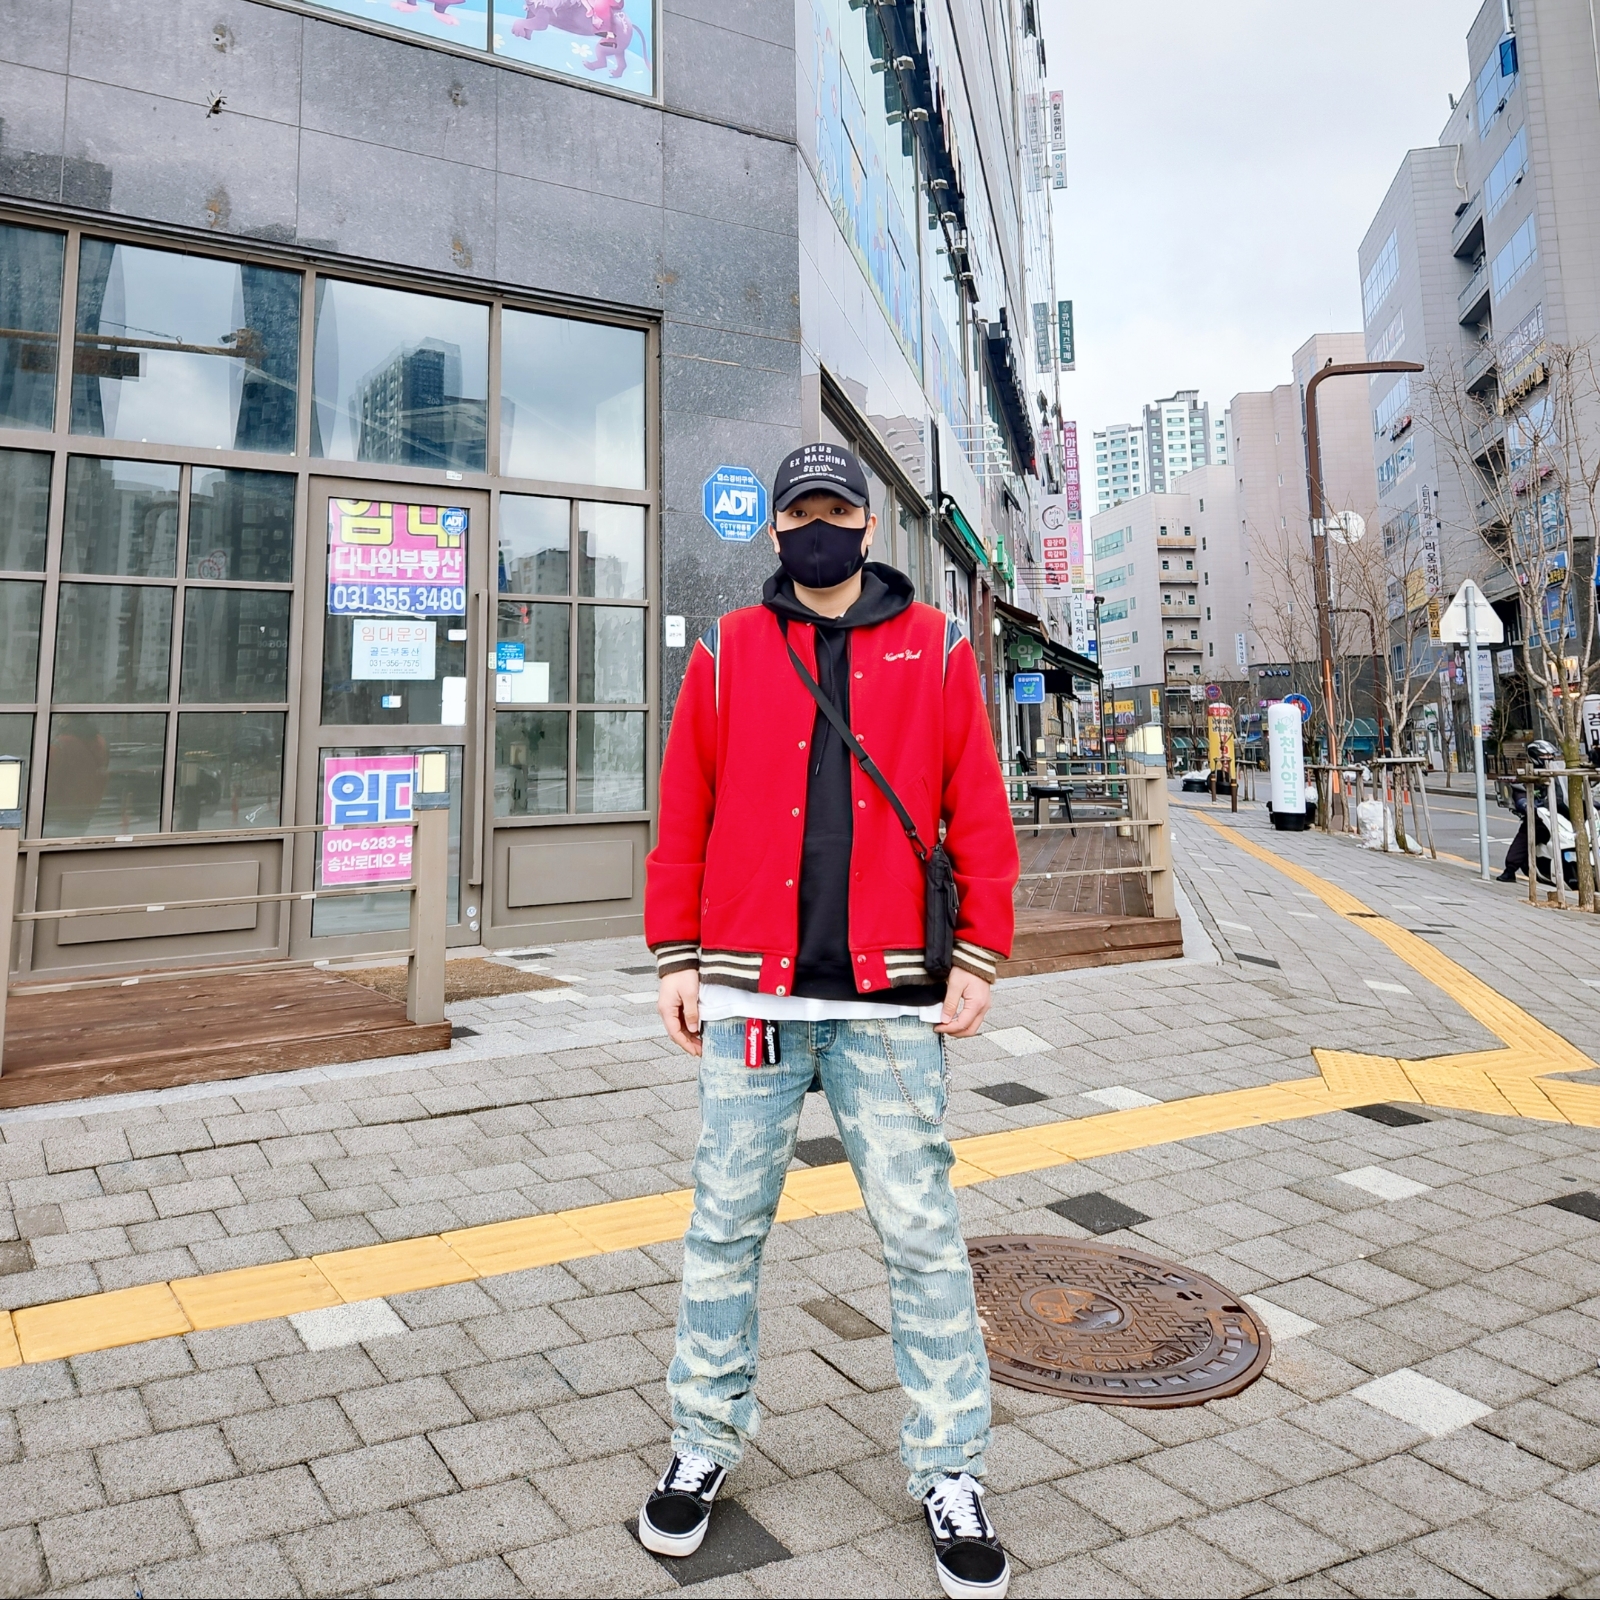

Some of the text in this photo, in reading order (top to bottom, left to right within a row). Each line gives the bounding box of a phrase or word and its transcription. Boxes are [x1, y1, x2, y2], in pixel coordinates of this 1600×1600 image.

[804, 445, 832, 454] DEUS
[1066, 438, 1077, 468] 아로마
[790, 454, 847, 468] EX MACHINA
[803, 464, 834, 473] SEOUL
[714, 489, 757, 517] ADT
[445, 515, 464, 527] ADT
[335, 547, 462, 580] 다나와부동산
[333, 586, 465, 611] 031.355.3480
[361, 626, 428, 643] 임대문의
[370, 646, 419, 657] 골드부동산
[1017, 645, 1033, 661] 약
[369, 659, 420, 668] 031-356-7575
[1279, 736, 1299, 808] 천사약국
[327, 855, 396, 872] 송산로데오
[748, 1026, 760, 1066] Supreme
[765, 1026, 776, 1064] Supreme
[1092, 1351, 1181, 1371] telecom
